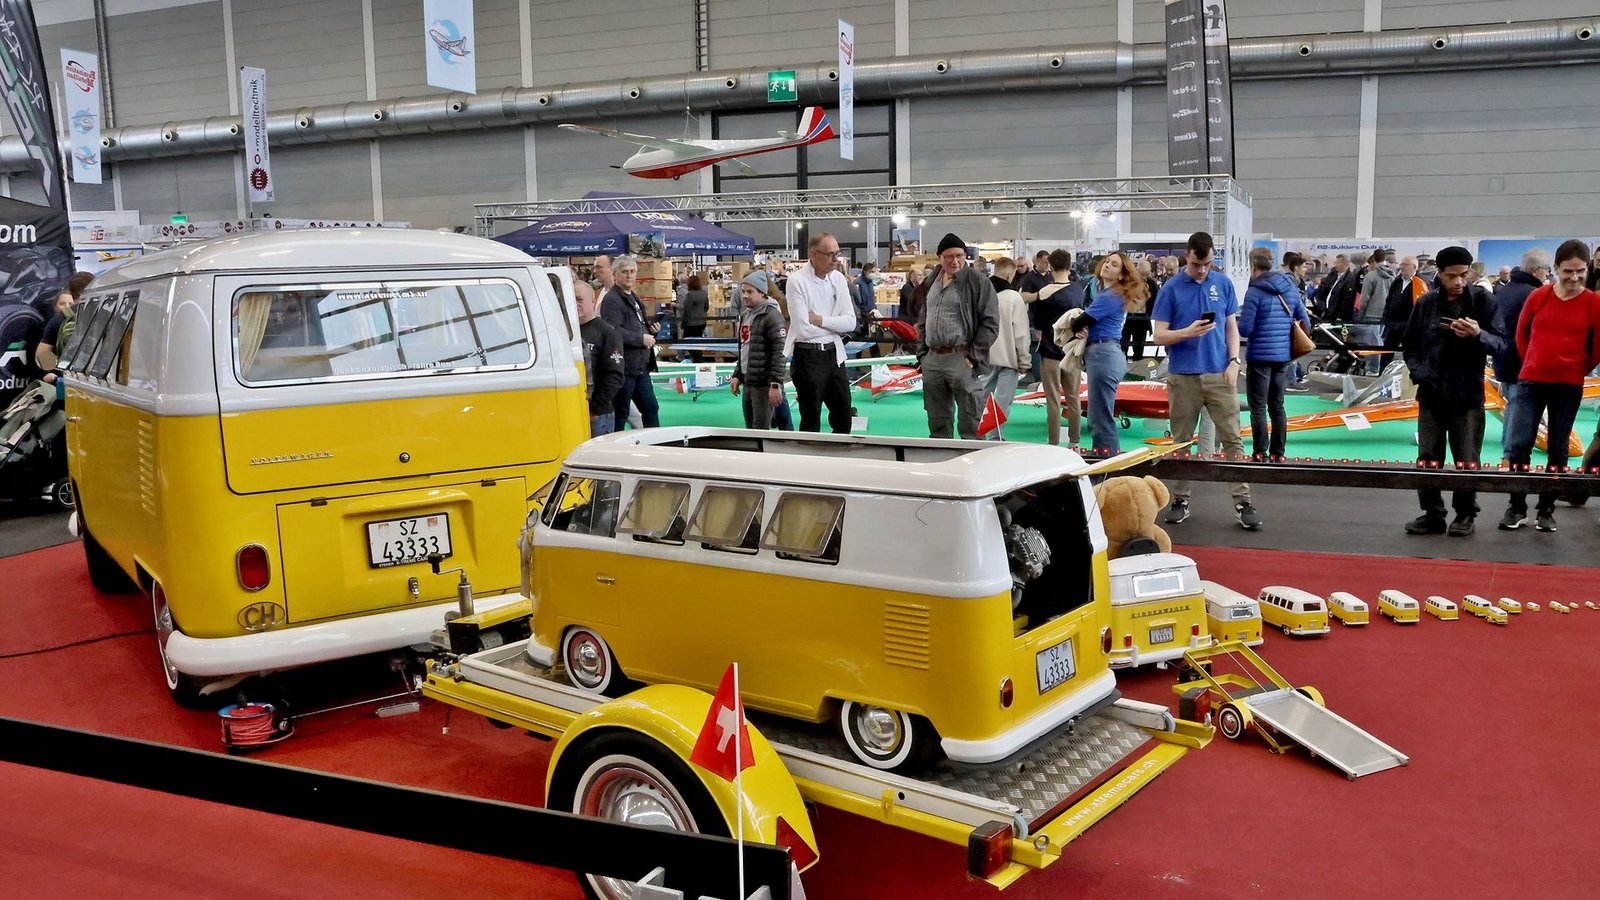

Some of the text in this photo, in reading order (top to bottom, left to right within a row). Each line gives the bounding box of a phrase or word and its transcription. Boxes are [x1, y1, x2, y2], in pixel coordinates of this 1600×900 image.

[250, 79, 262, 148] modelltechnik
[255, 170, 263, 188] mk
[250, 450, 335, 466] VOLKSWAGEN
[400, 519, 419, 536] SZ
[383, 535, 440, 561] 43333
[244, 604, 276, 629] CH
[1050, 646, 1060, 662] SZ
[1044, 658, 1070, 686] 43333
[1061, 758, 1158, 827] www.xtremecars.ch
